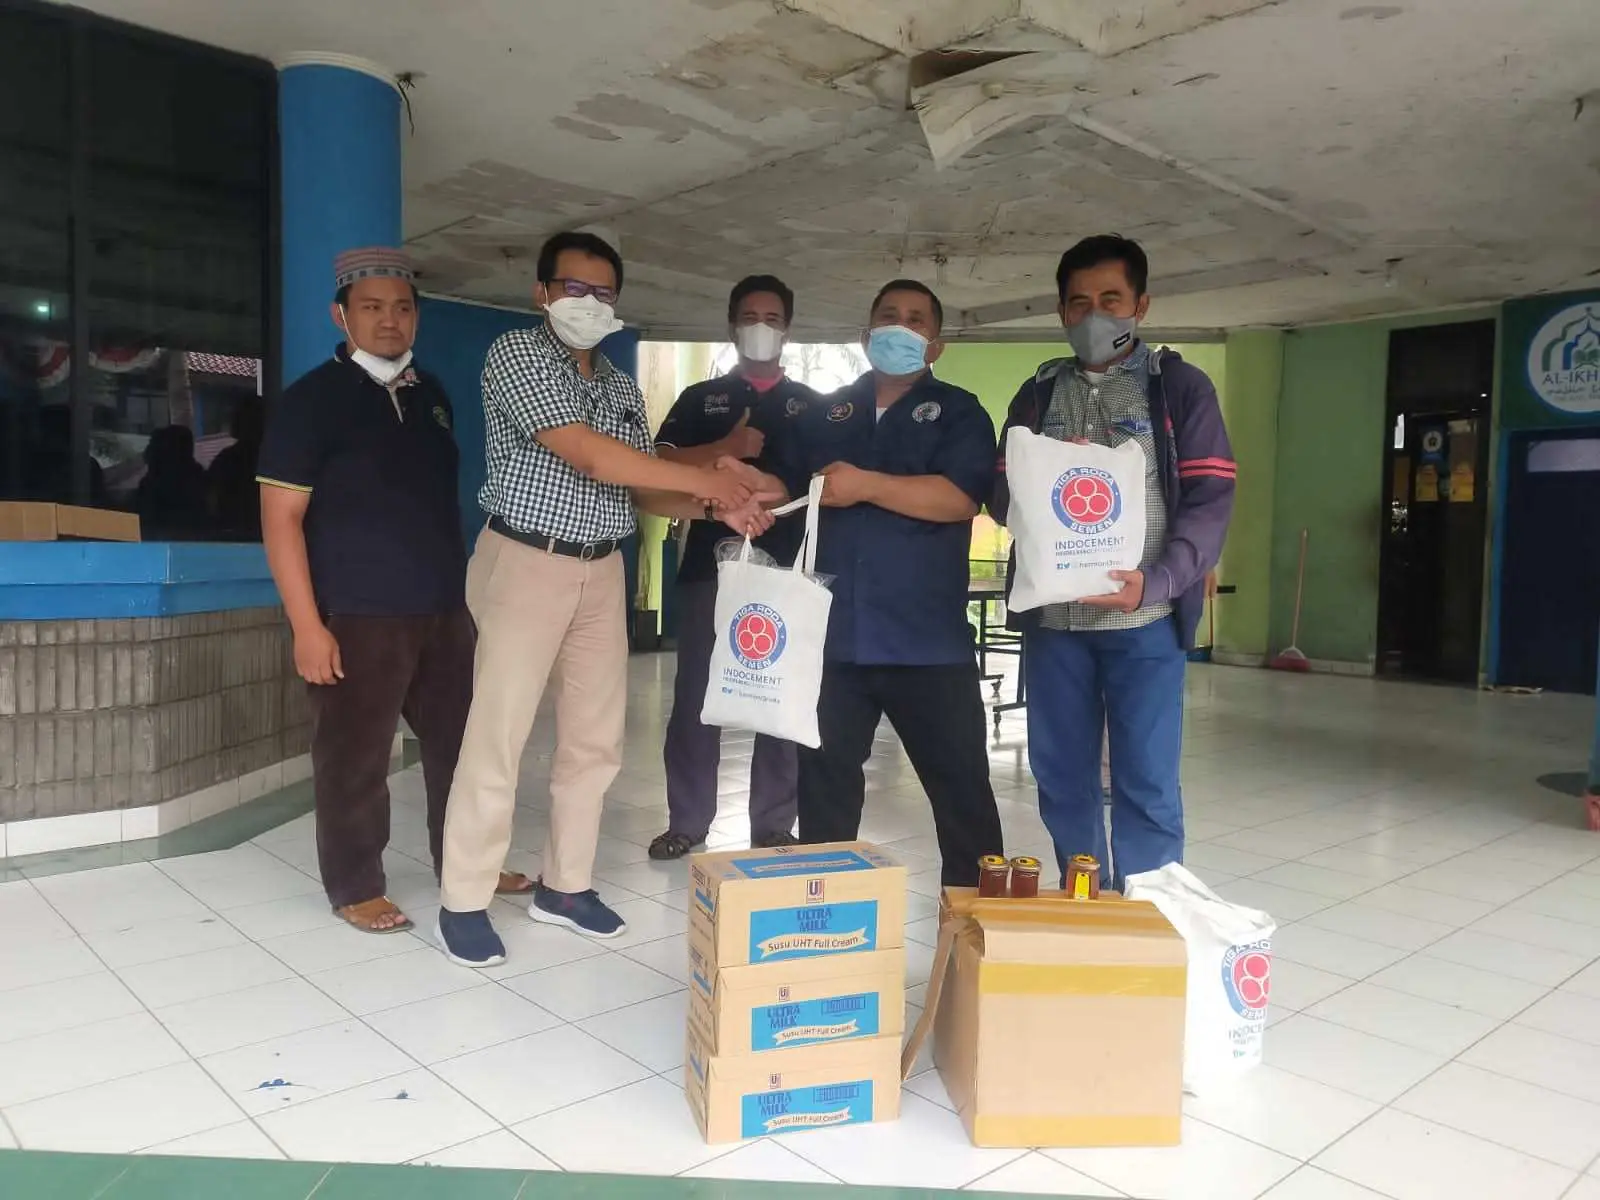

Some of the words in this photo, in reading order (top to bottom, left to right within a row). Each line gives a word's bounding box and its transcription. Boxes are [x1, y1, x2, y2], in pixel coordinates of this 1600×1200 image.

[1080, 467, 1115, 486] RODA
[1070, 519, 1113, 535] SEMEN
[1055, 536, 1124, 550] INDOCEMENT
[723, 667, 784, 685] INDOCEMENT
[796, 907, 832, 921] ULTRA
[799, 919, 828, 932] MILK
[768, 940, 789, 951] Susu
[793, 938, 812, 948] UHT
[814, 938, 830, 948] Full
[832, 936, 859, 947] Cream
[767, 1004, 801, 1019] ULTRA
[770, 1015, 798, 1029] MILK
[782, 1028, 799, 1038] Susu
[800, 1028, 815, 1036] UHT
[816, 1027, 829, 1036] Full
[830, 1024, 852, 1034] Cream
[758, 1091, 792, 1106] ULTRA
[760, 1103, 789, 1117] MILK
